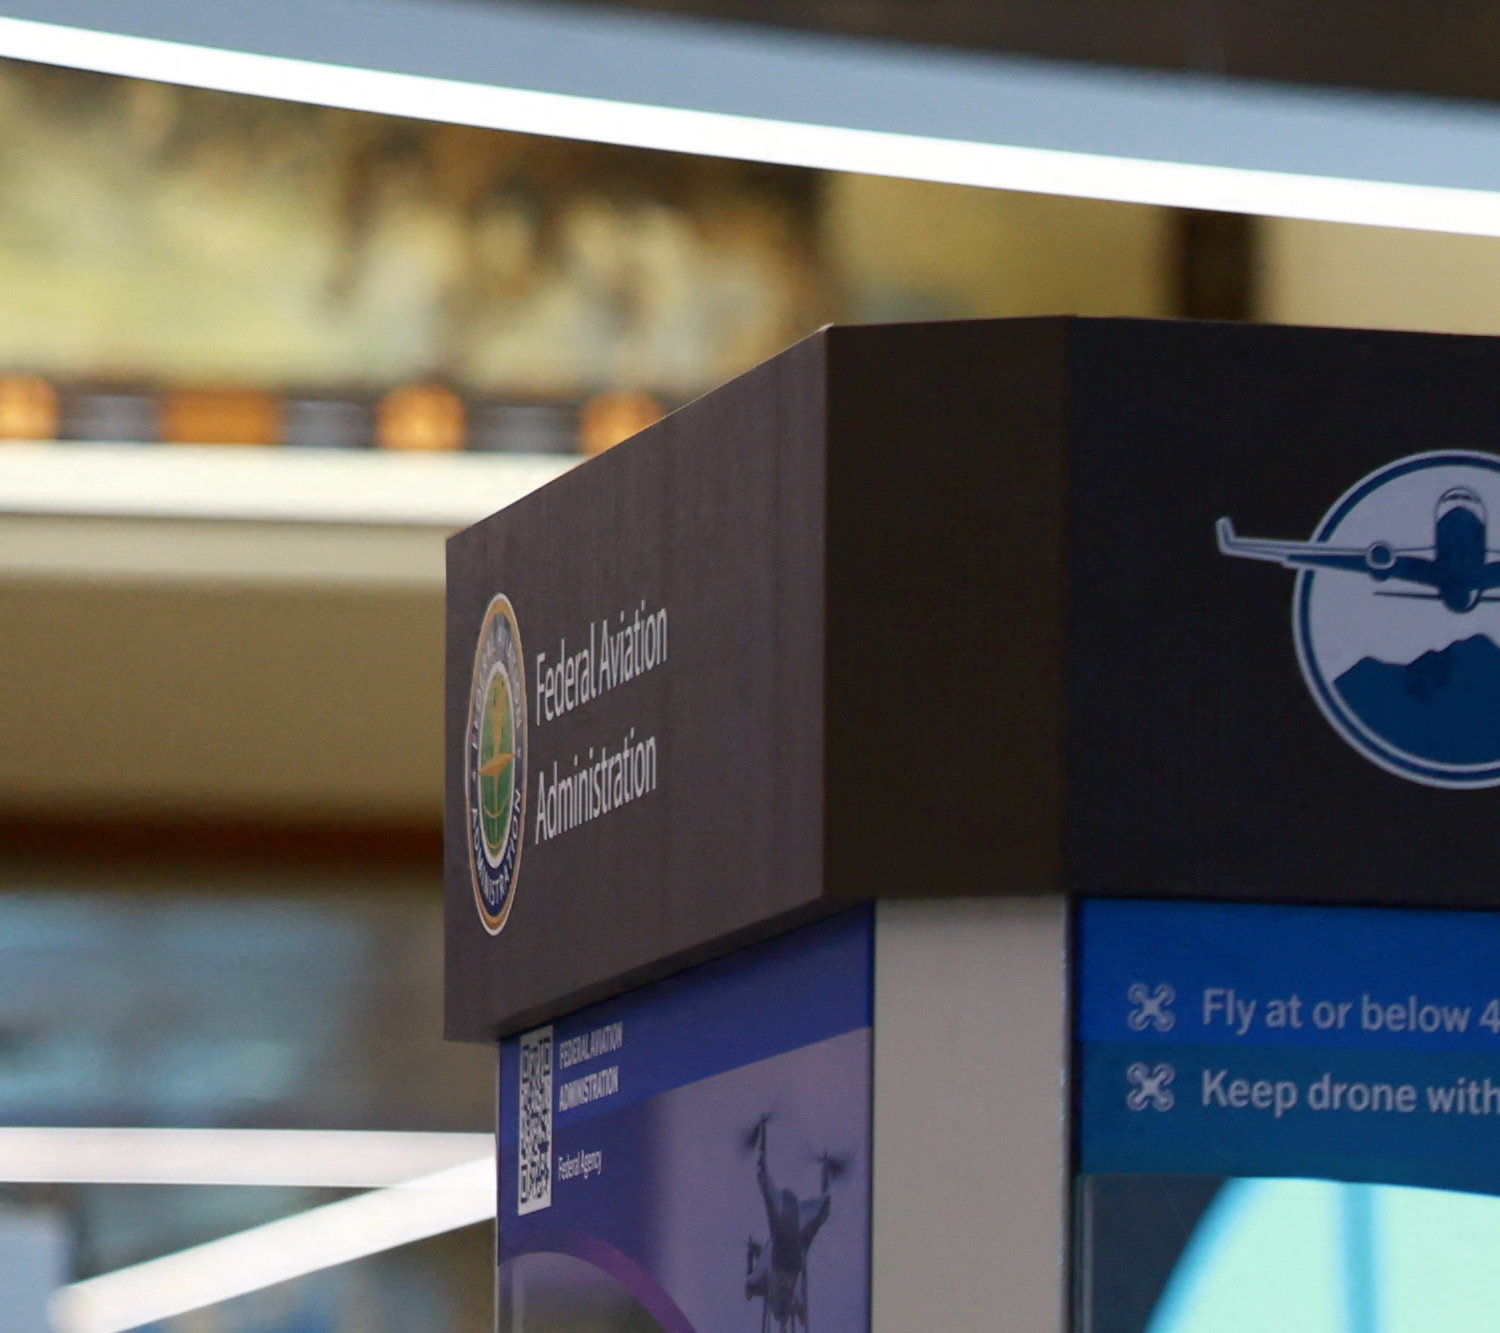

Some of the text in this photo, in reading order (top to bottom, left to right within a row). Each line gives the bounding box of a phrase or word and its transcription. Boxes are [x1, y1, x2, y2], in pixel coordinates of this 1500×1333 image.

[536, 599, 667, 726] Federal Aviation
[535, 727, 656, 844] Administration
[1202, 988, 1257, 1036] Fly
[1265, 993, 1303, 1029] at
[1312, 1000, 1352, 1030] or
[1361, 993, 1472, 1034] below
[1201, 1069, 1298, 1119] Keep
[1308, 1072, 1418, 1113] drone
